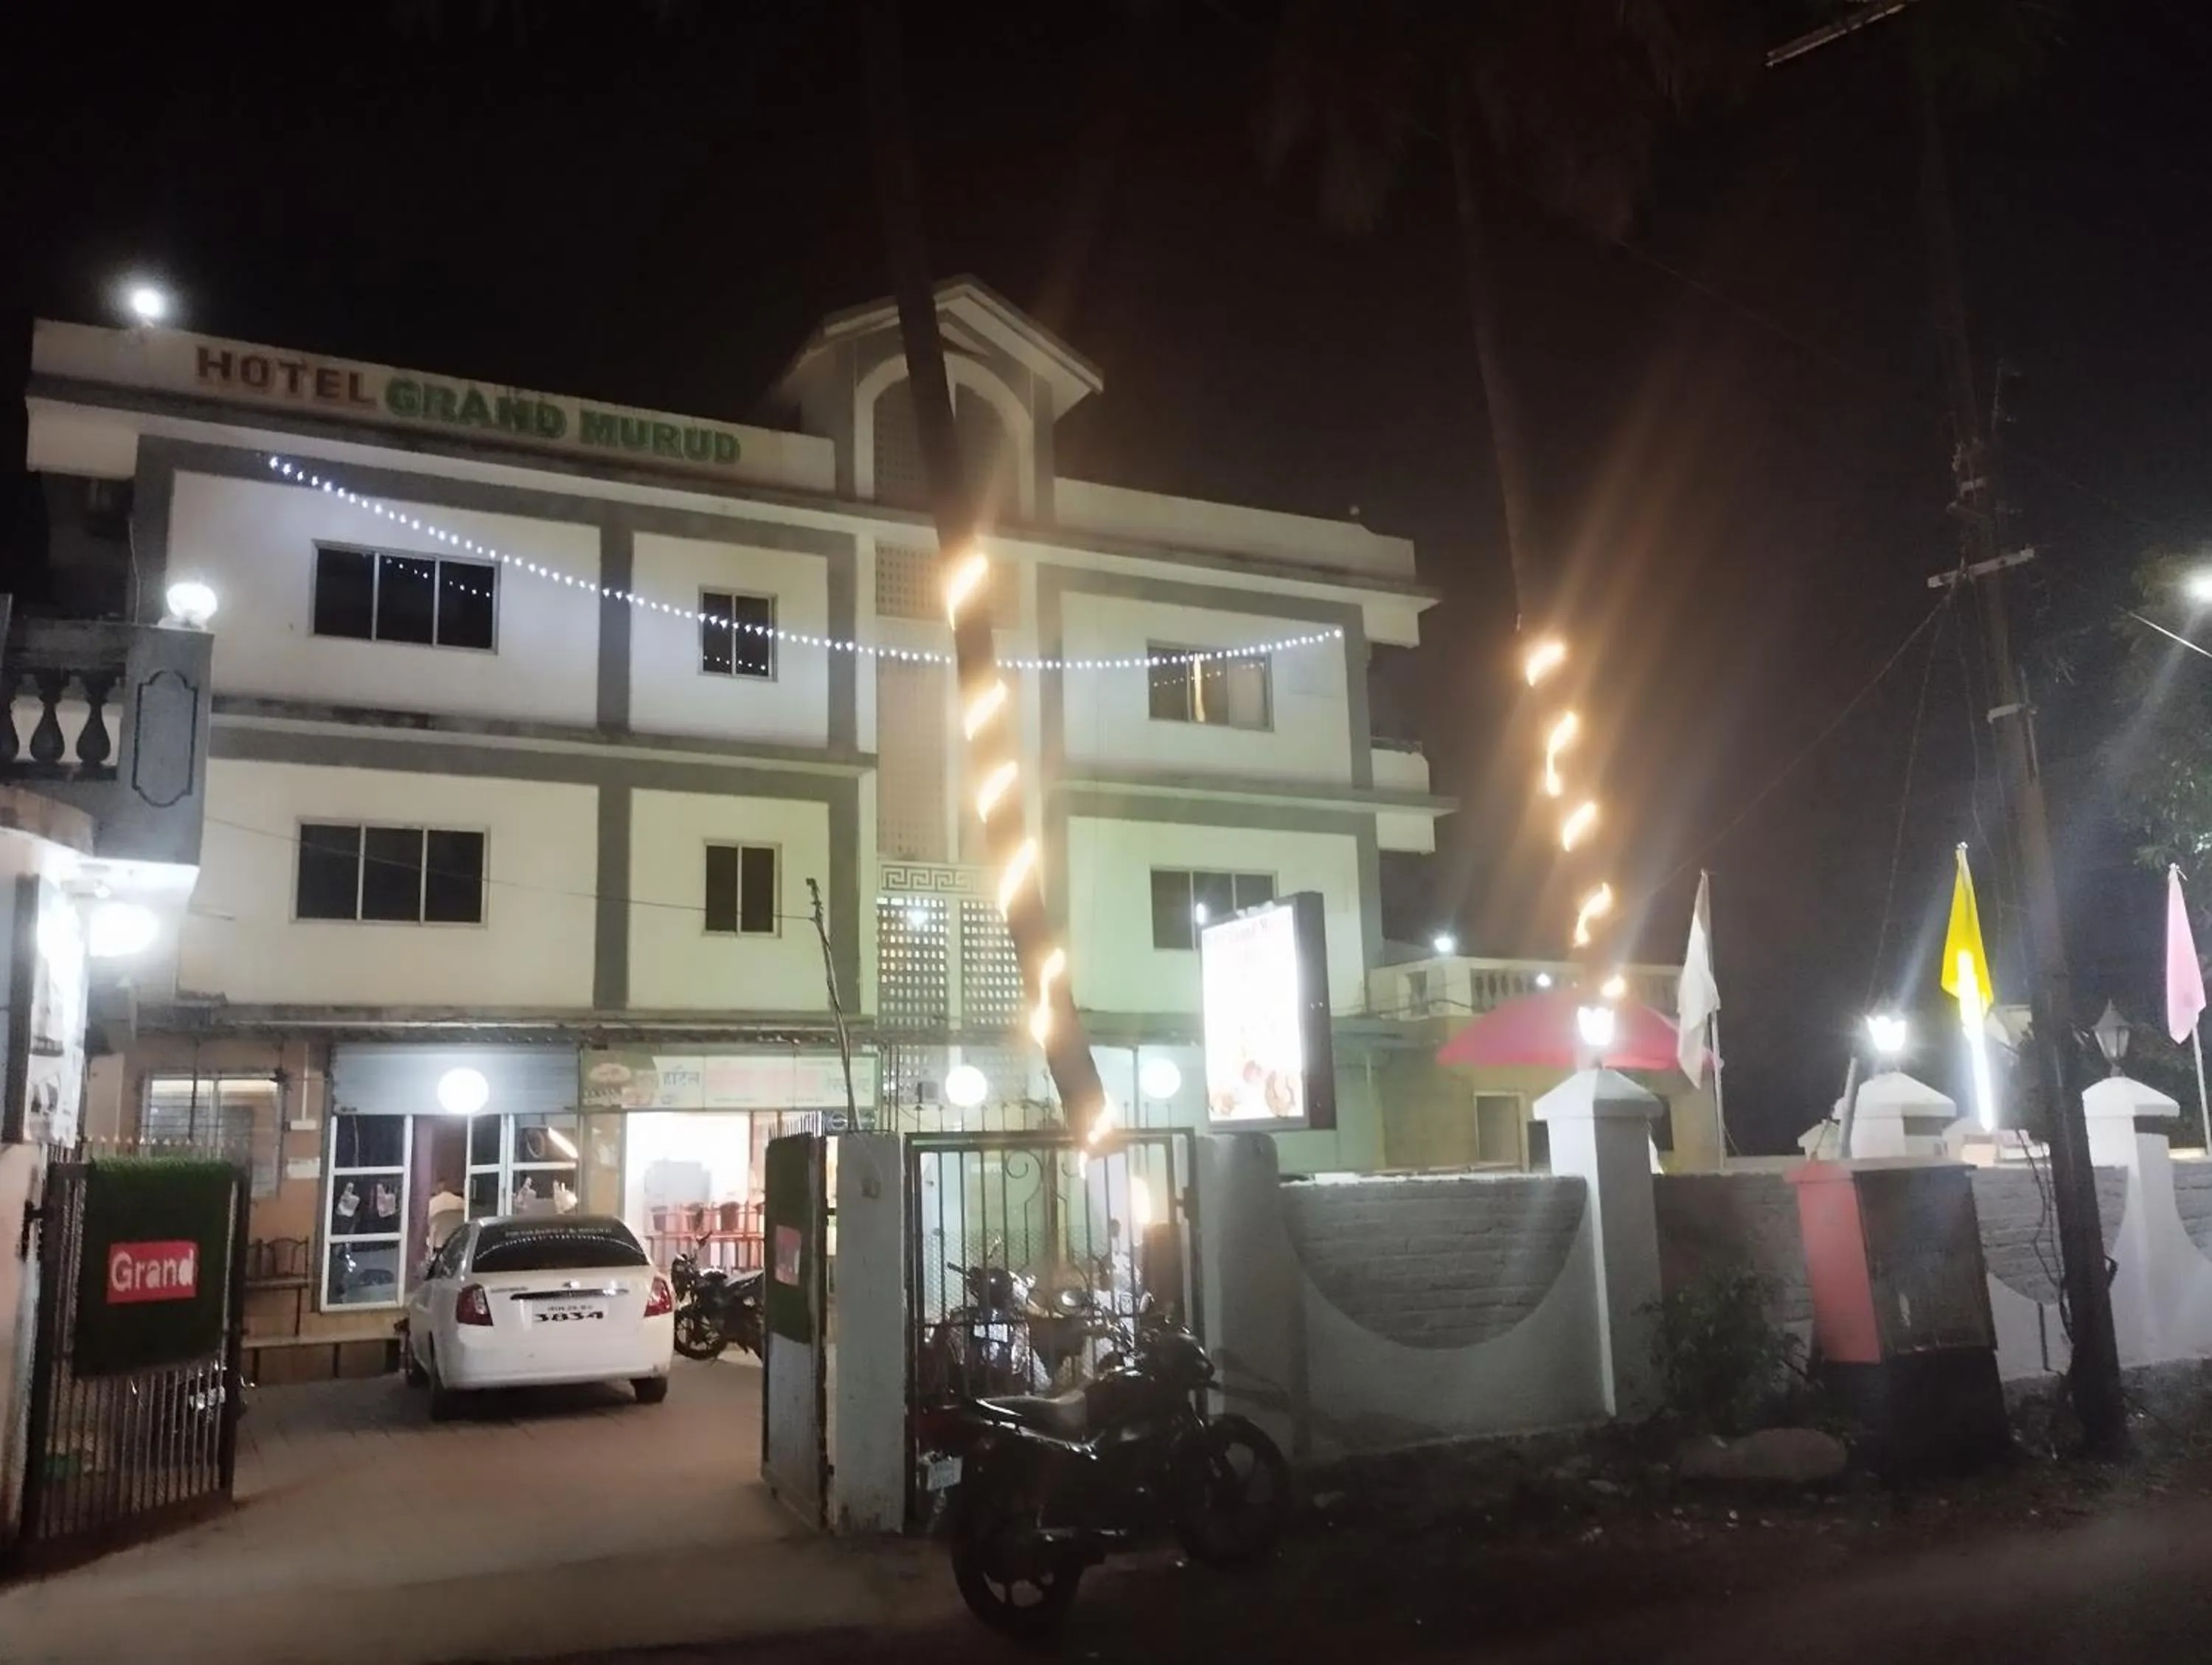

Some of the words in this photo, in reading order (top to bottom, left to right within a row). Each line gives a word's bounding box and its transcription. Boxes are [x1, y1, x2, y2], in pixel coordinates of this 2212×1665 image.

[197, 347, 378, 406] HOTEL
[385, 376, 567, 440] GRAND
[579, 409, 742, 465] MURUD
[110, 1248, 195, 1292] Grand
